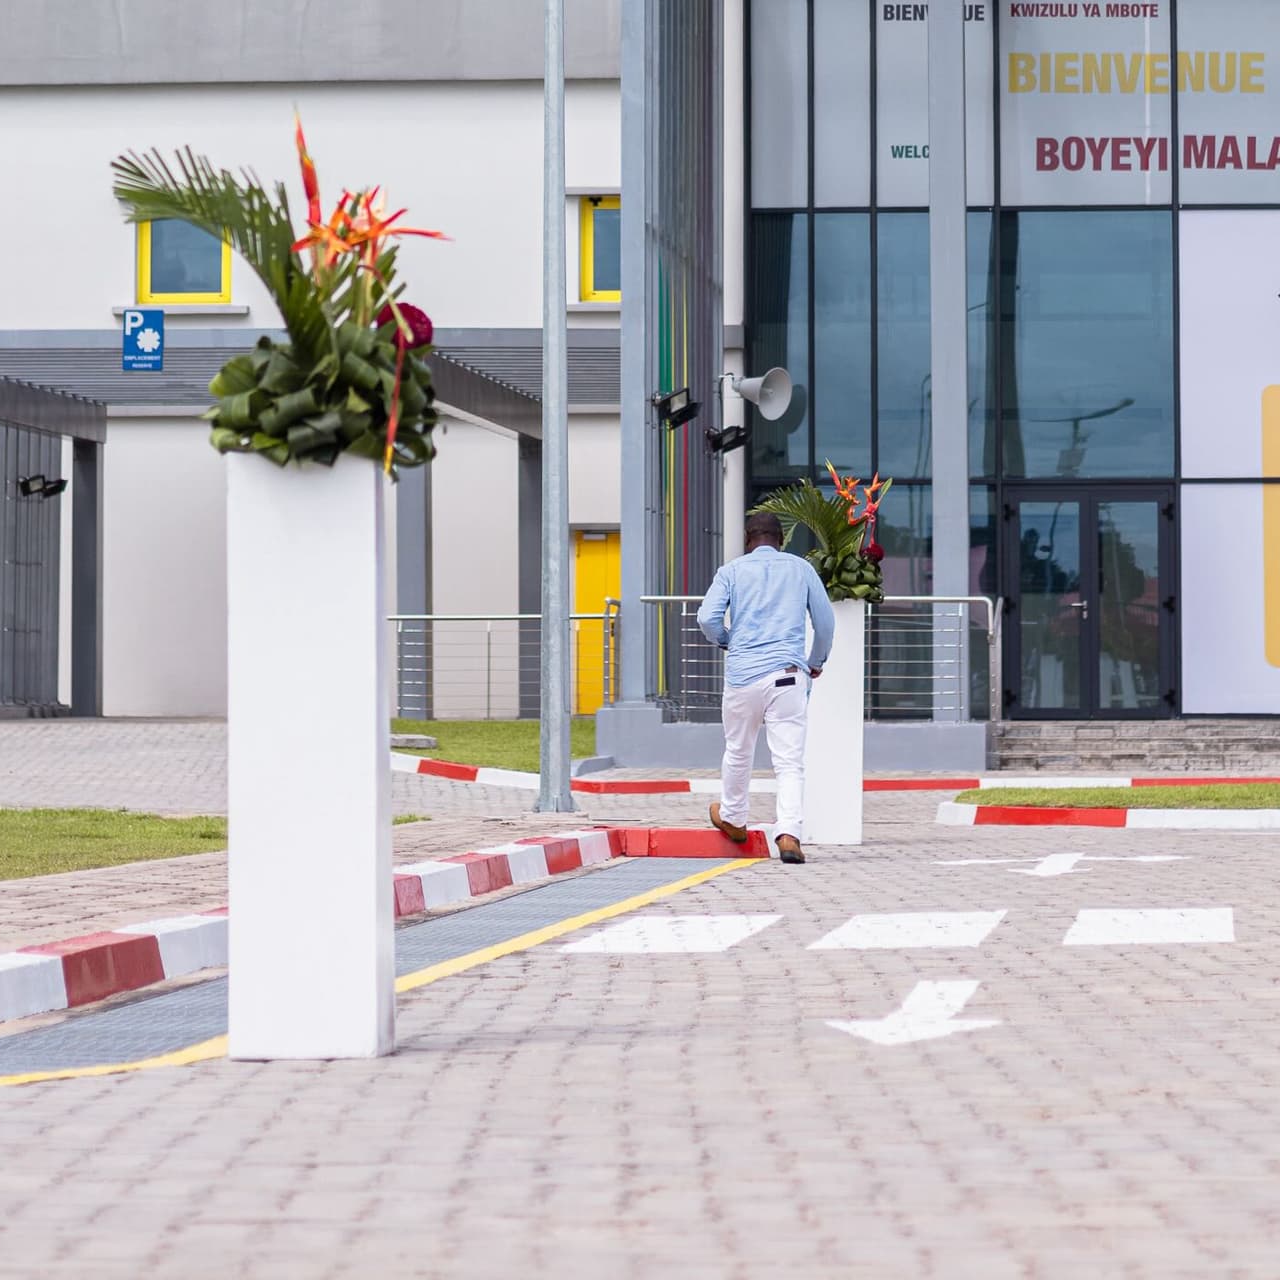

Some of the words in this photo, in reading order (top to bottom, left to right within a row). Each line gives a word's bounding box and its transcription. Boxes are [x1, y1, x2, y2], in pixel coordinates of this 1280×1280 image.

[884, 4, 985, 21] BIENUE
[1010, 3, 1078, 18] KWIZULU
[1082, 3, 1101, 18] YA
[1105, 3, 1159, 18] MBOTE
[1008, 52, 1264, 94] BIENVENUE
[891, 145, 930, 159] WELC
[1036, 137, 1168, 172] BOYEYI
[125, 311, 144, 336] P
